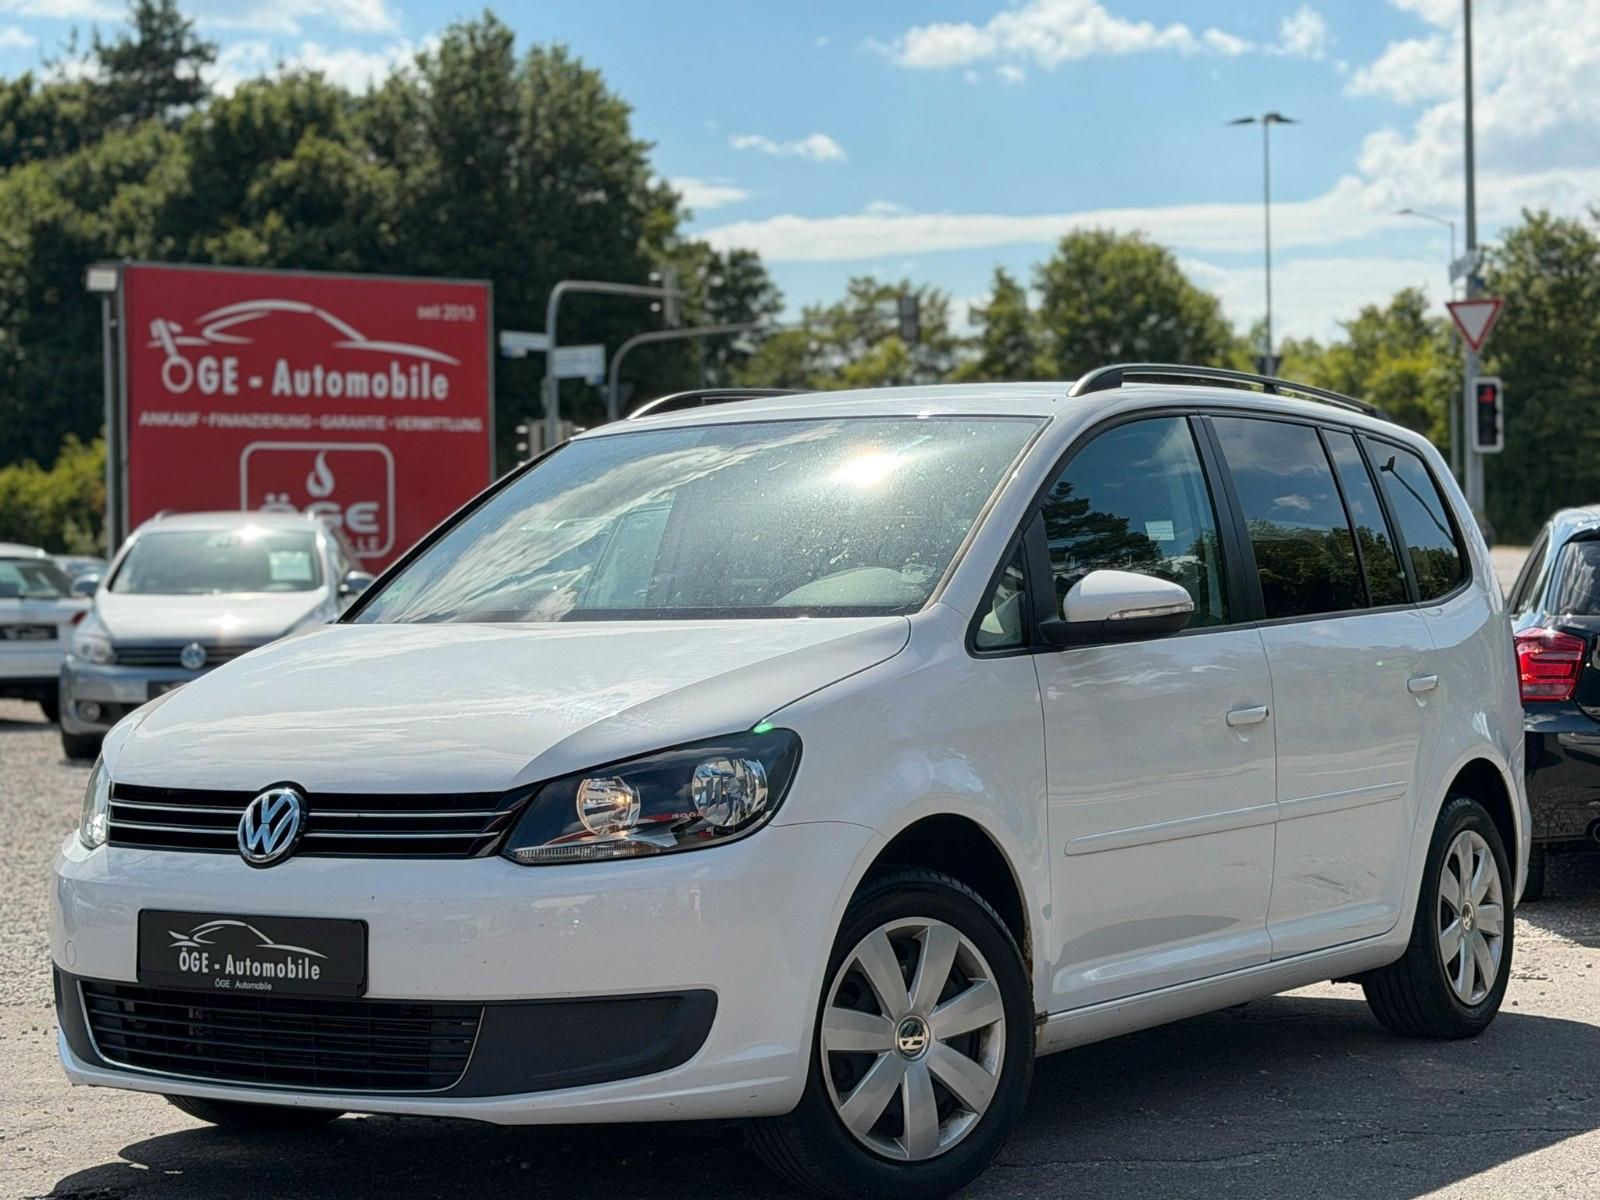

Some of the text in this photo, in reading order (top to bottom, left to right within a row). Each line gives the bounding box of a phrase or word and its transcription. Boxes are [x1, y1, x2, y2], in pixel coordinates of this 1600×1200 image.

[441, 303, 477, 322] 2013
[271, 358, 449, 400] Automobile
[138, 410, 483, 432] ANKAUF FINANZIERUNG GARANTIE VERMITTLUNG
[179, 947, 209, 974] ÖGE
[225, 953, 320, 980] Automobile
[214, 977, 272, 991] ÖGE Automobile
